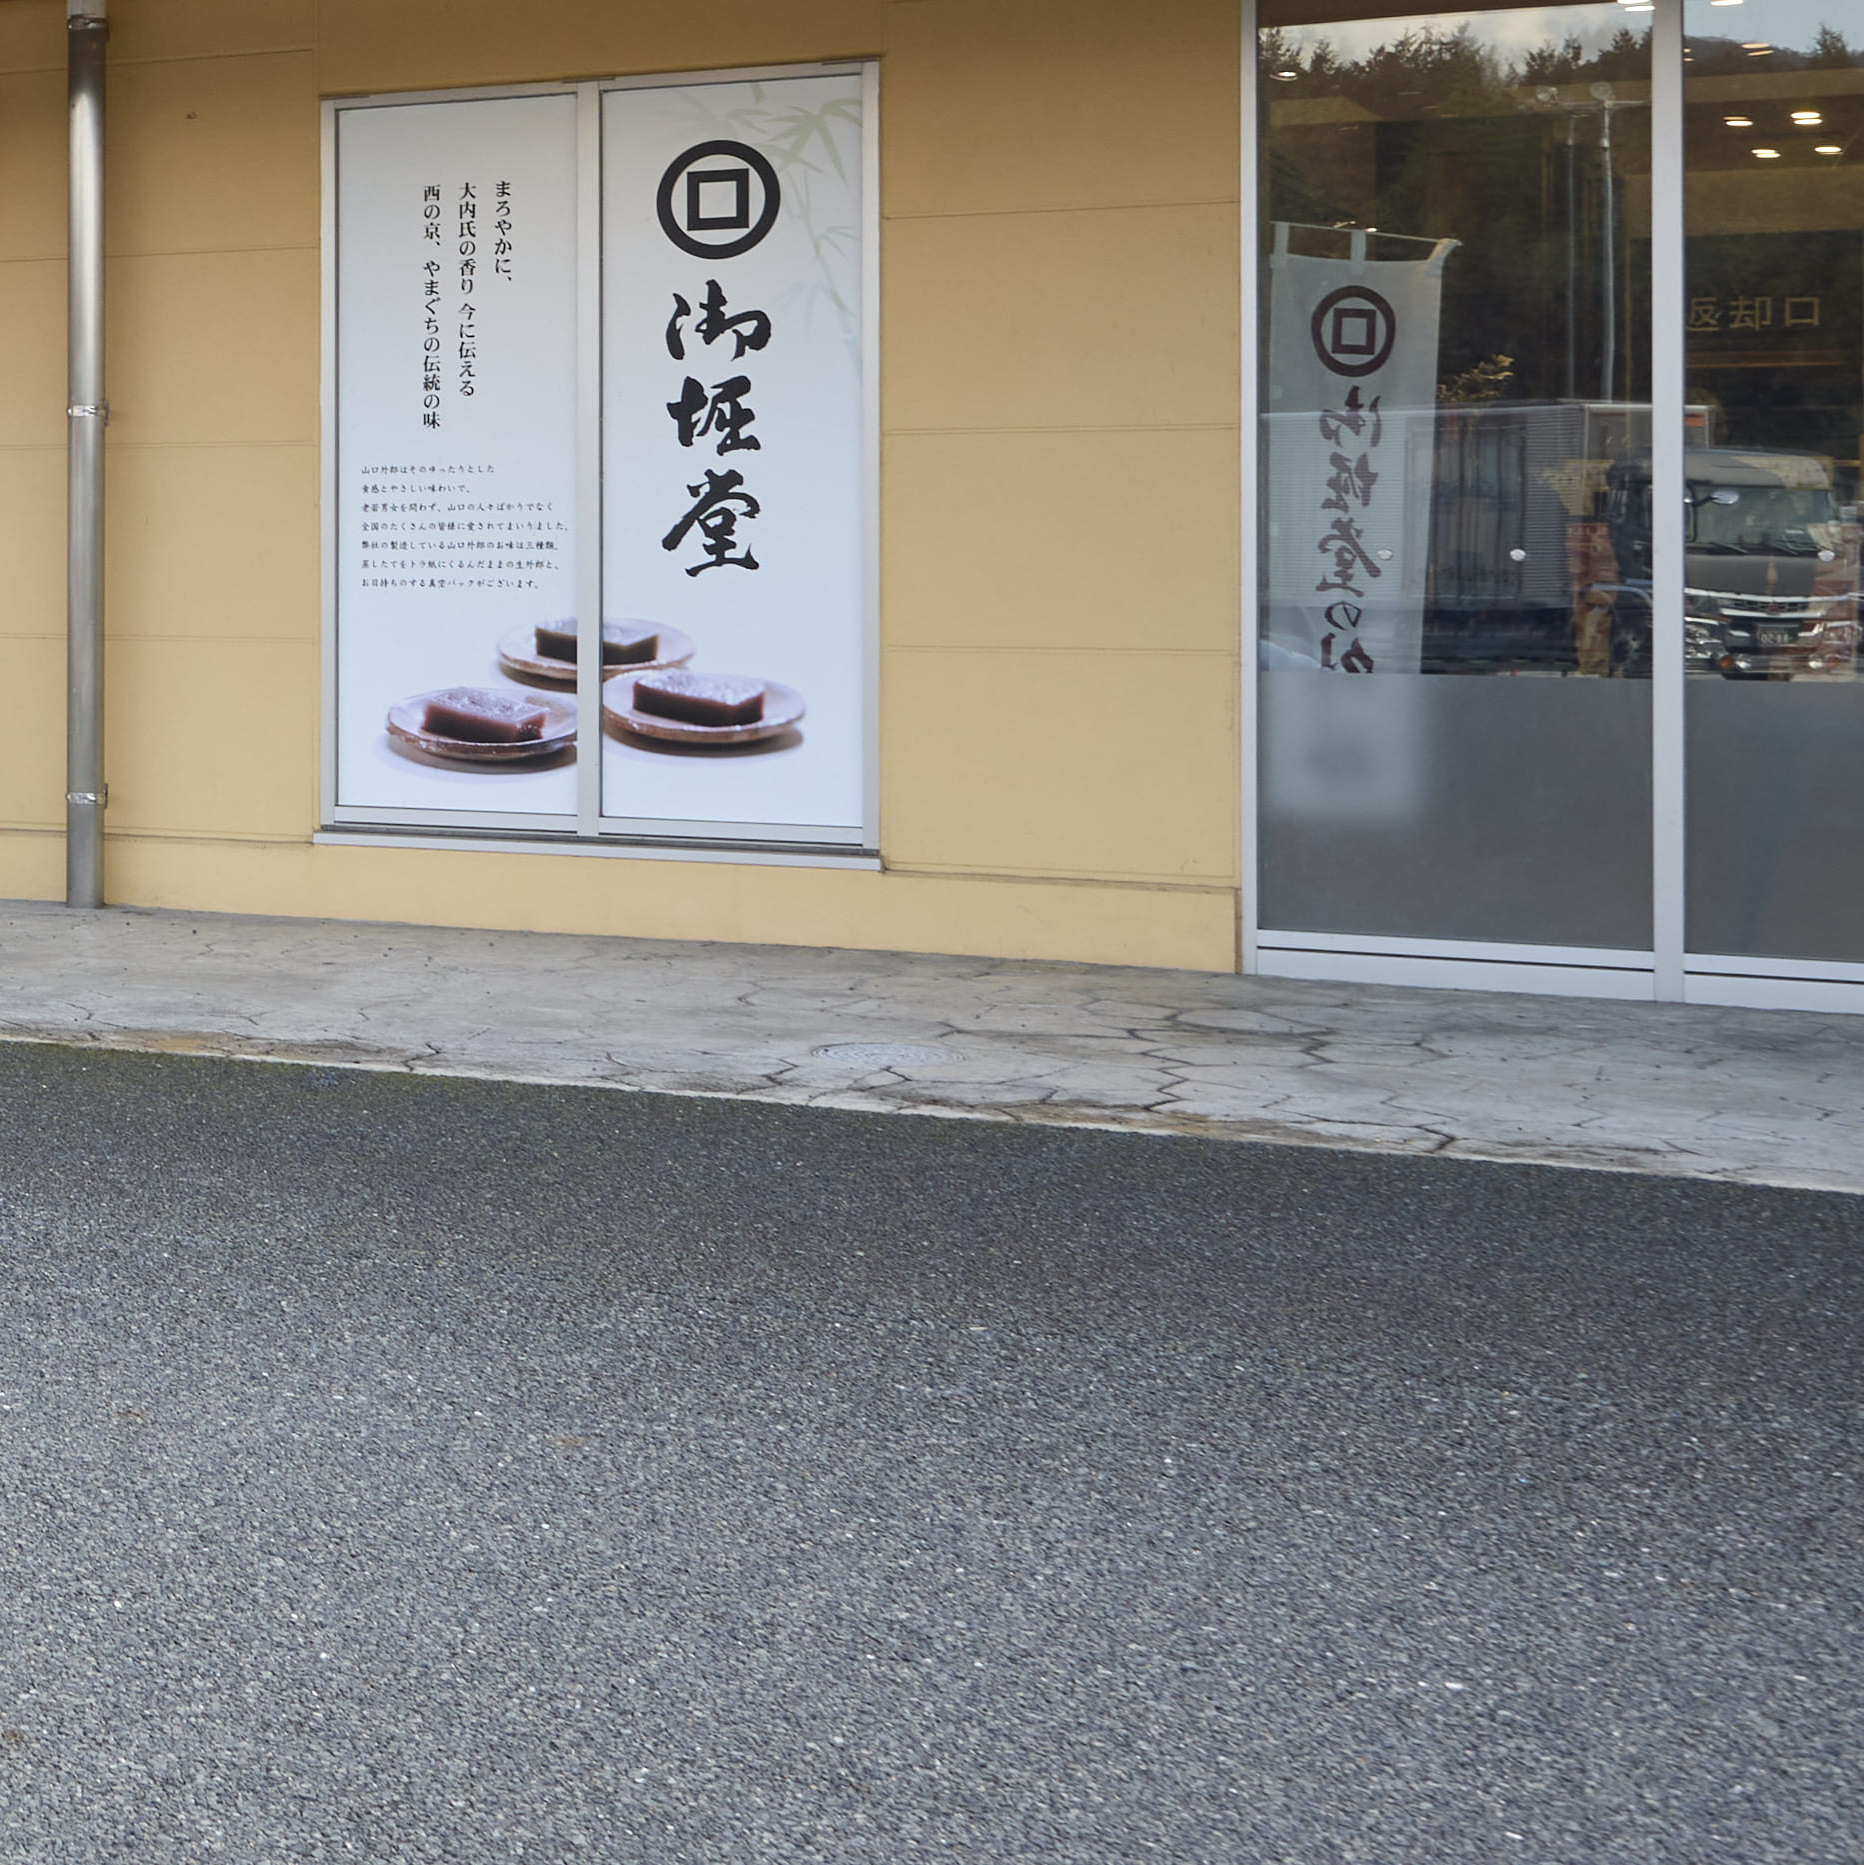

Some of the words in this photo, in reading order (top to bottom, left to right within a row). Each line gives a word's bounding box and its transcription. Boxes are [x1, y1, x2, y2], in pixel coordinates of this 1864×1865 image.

[458, 183, 477, 296] 大内氏の香り
[494, 180, 513, 283] まろやかに、
[458, 303, 477, 397] 今に伝える
[1686, 296, 1820, 332] 返却口
[662, 279, 772, 577] 御堀堂
